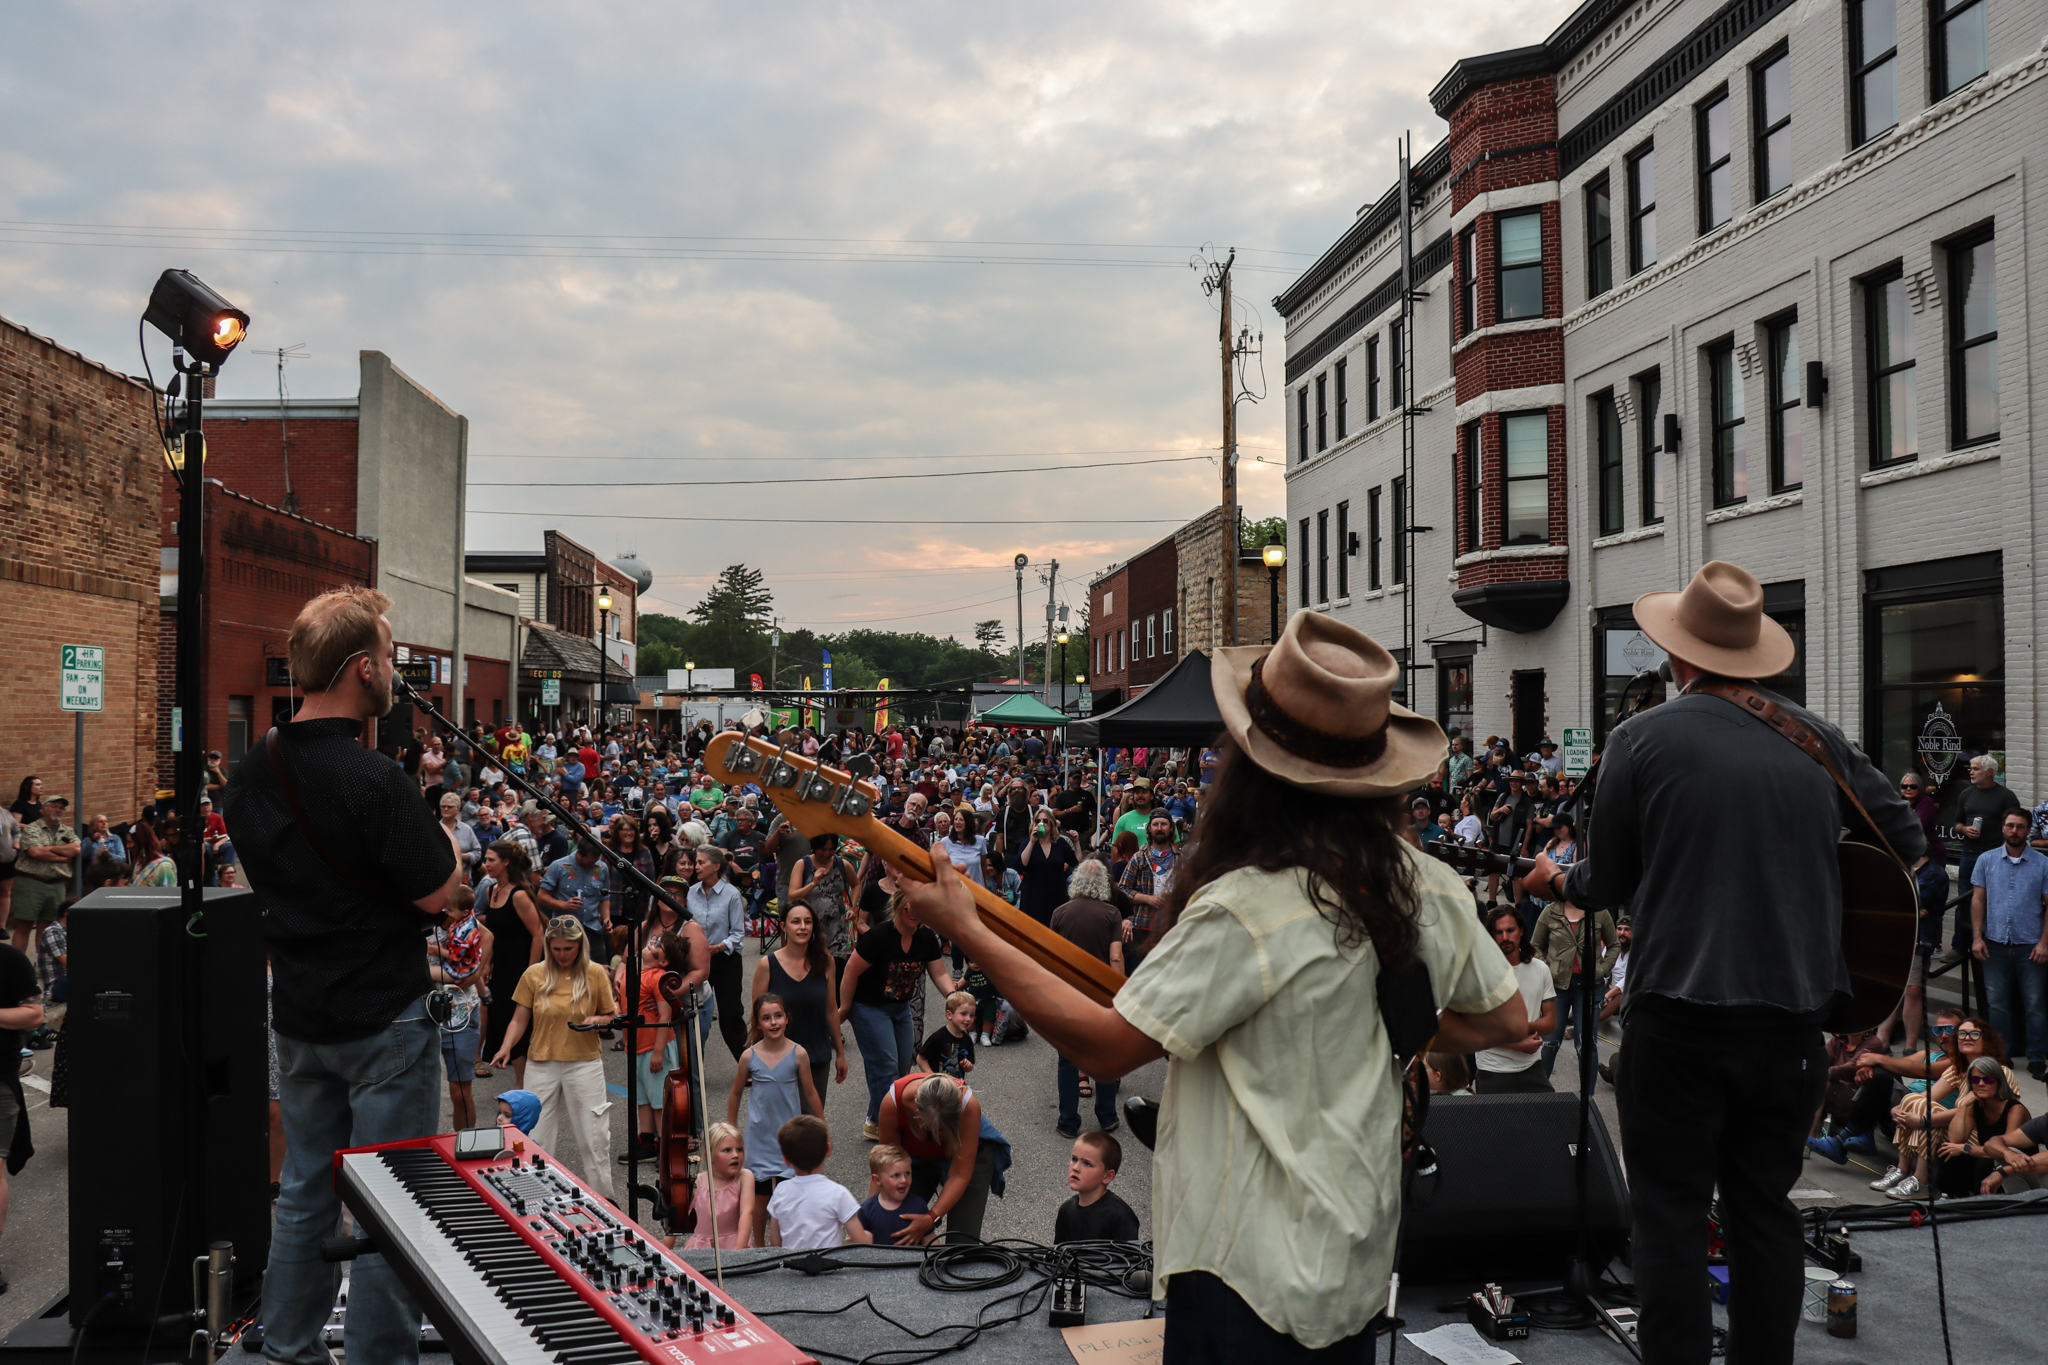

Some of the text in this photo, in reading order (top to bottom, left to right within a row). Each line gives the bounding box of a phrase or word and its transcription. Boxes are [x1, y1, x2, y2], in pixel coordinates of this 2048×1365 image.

[65, 649, 74, 666] 2
[84, 649, 94, 658] HR
[77, 659, 102, 669] PARKING
[66, 673, 78, 682] 9AM
[87, 674, 99, 683] 5PM
[529, 670, 562, 678] RECORDS
[78, 685, 87, 694] ON
[66, 696, 98, 706] WEEKDAYS
[1564, 733, 1571, 742] 10
[1918, 738, 1961, 750] Noble Rind
[1077, 1337, 1152, 1354] PLEASE
